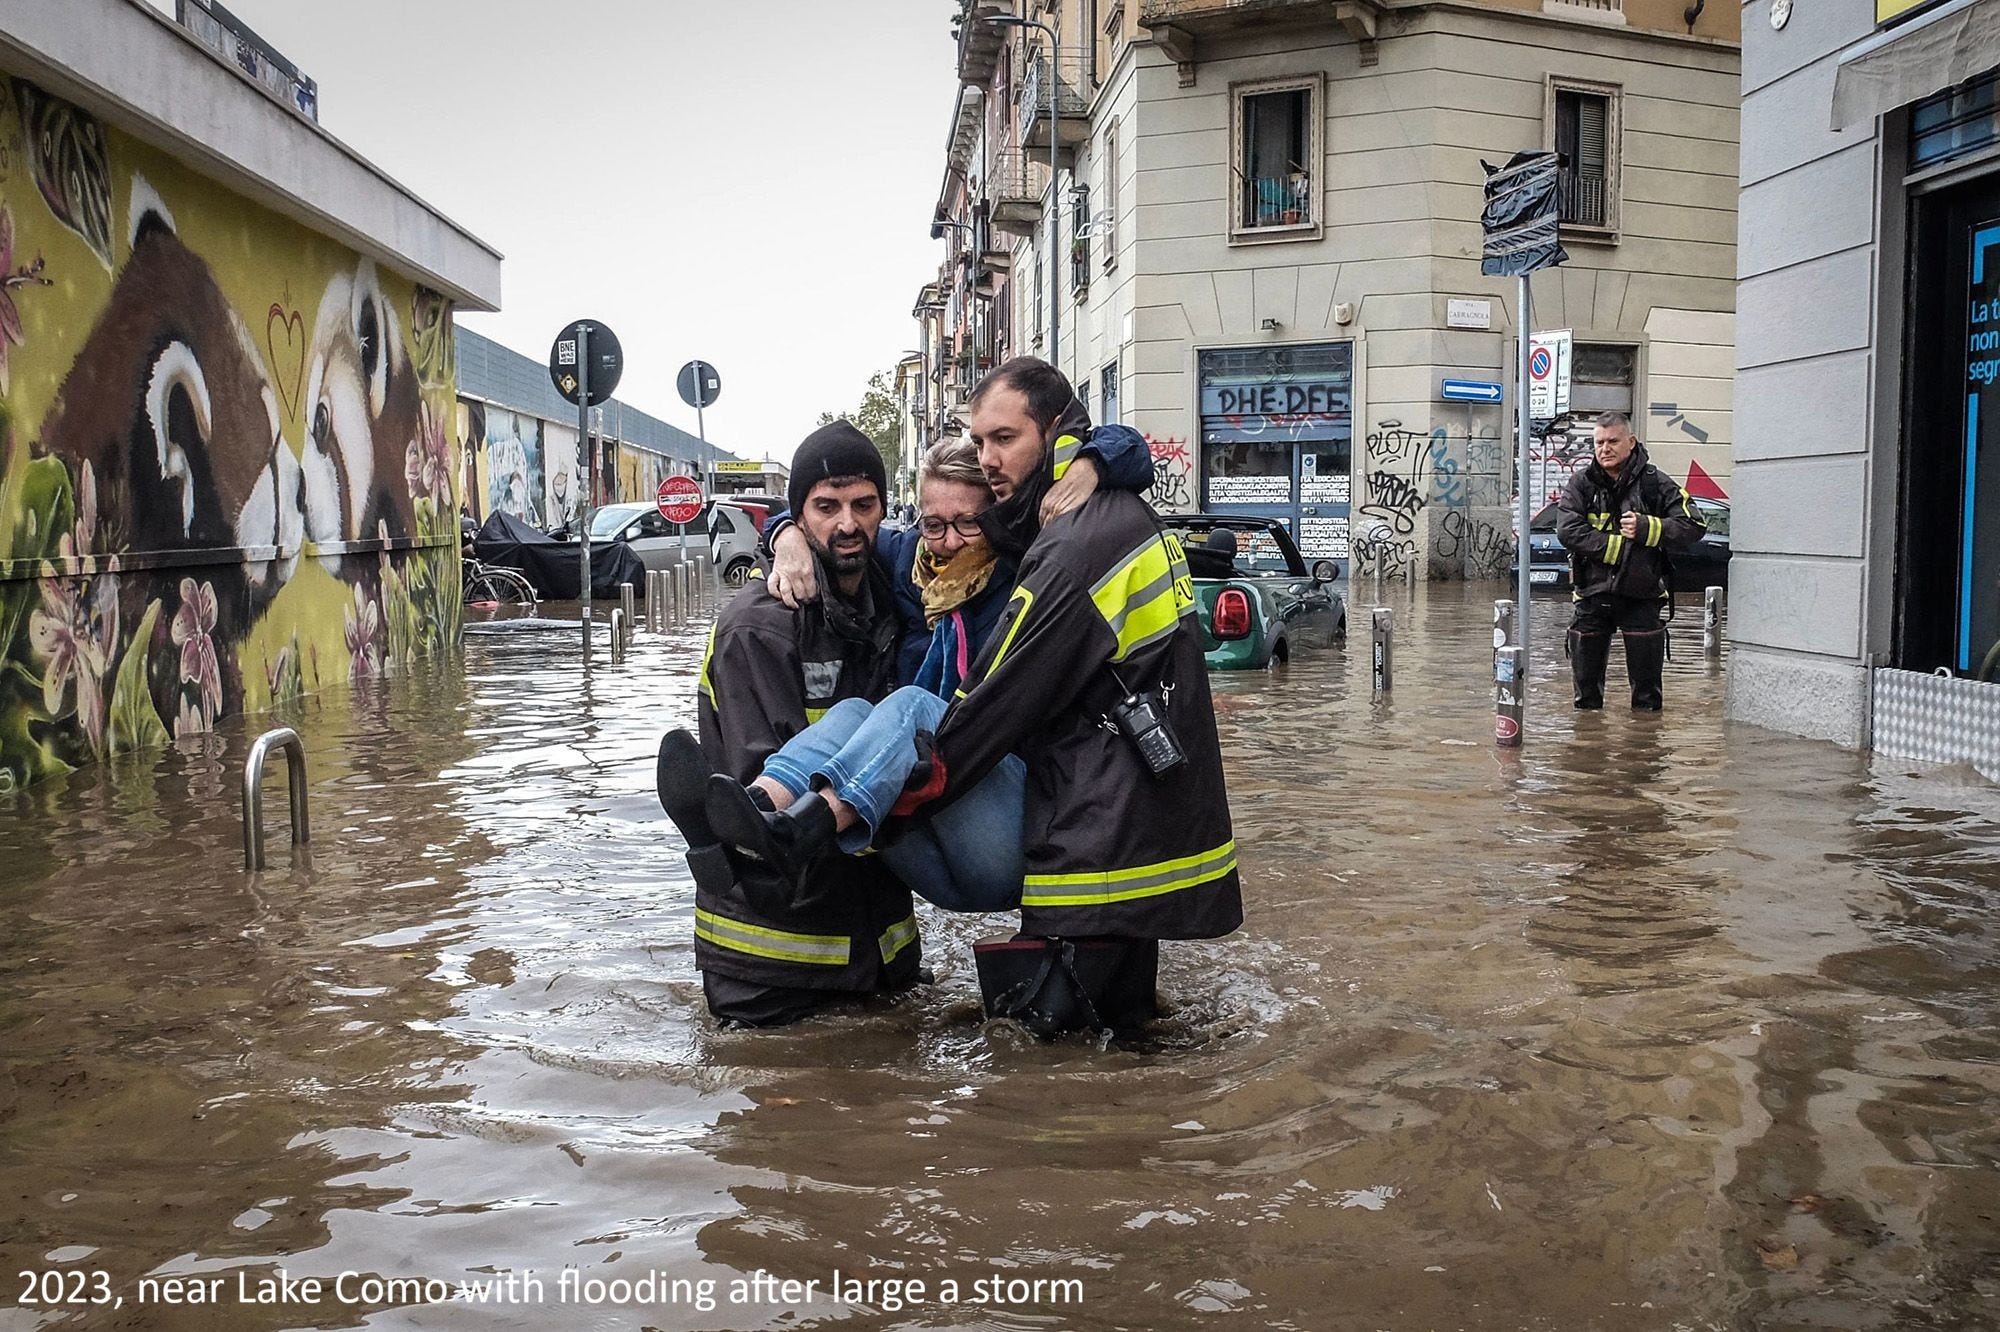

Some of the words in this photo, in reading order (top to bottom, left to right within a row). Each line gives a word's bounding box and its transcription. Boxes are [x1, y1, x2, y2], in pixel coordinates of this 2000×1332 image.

[1971, 301, 1988, 323] La
[560, 342, 575, 352] BNE
[1970, 331, 1999, 351] non
